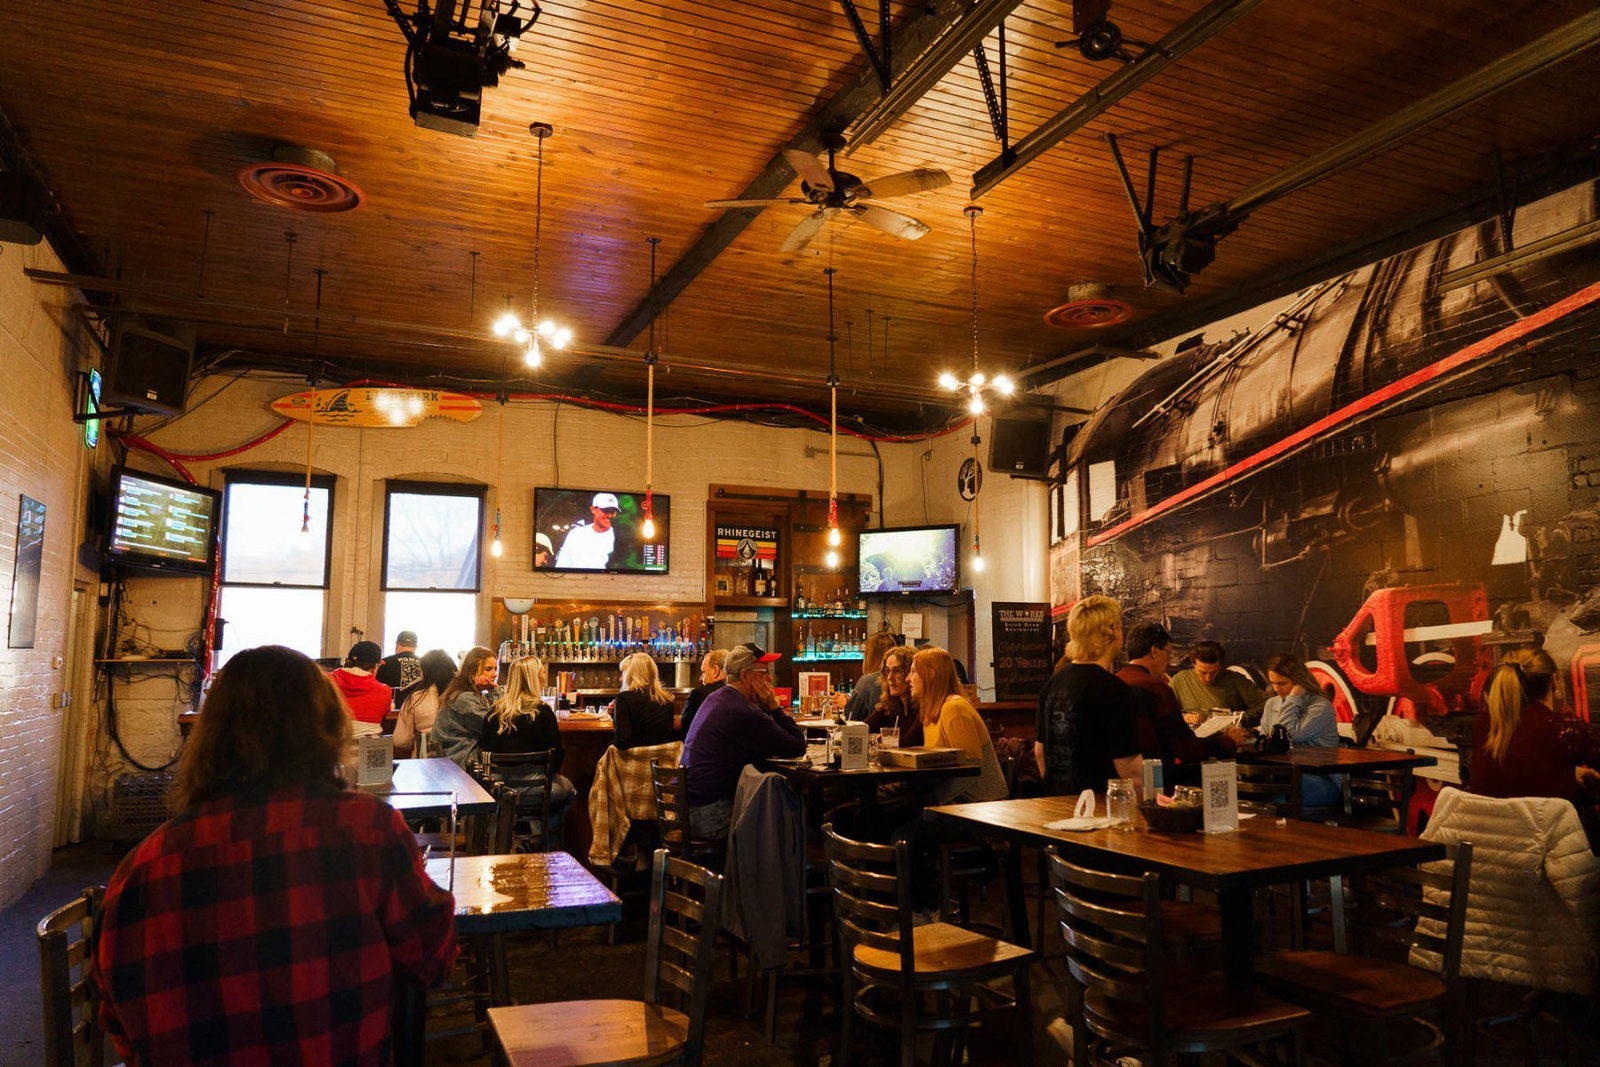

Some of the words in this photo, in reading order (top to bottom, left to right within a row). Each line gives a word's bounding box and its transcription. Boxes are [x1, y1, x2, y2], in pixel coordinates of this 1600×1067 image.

[717, 527, 777, 539] RHINEGEIST
[999, 610, 1014, 618] THE
[999, 656, 1013, 669] 20
[1014, 656, 1048, 669] Years
